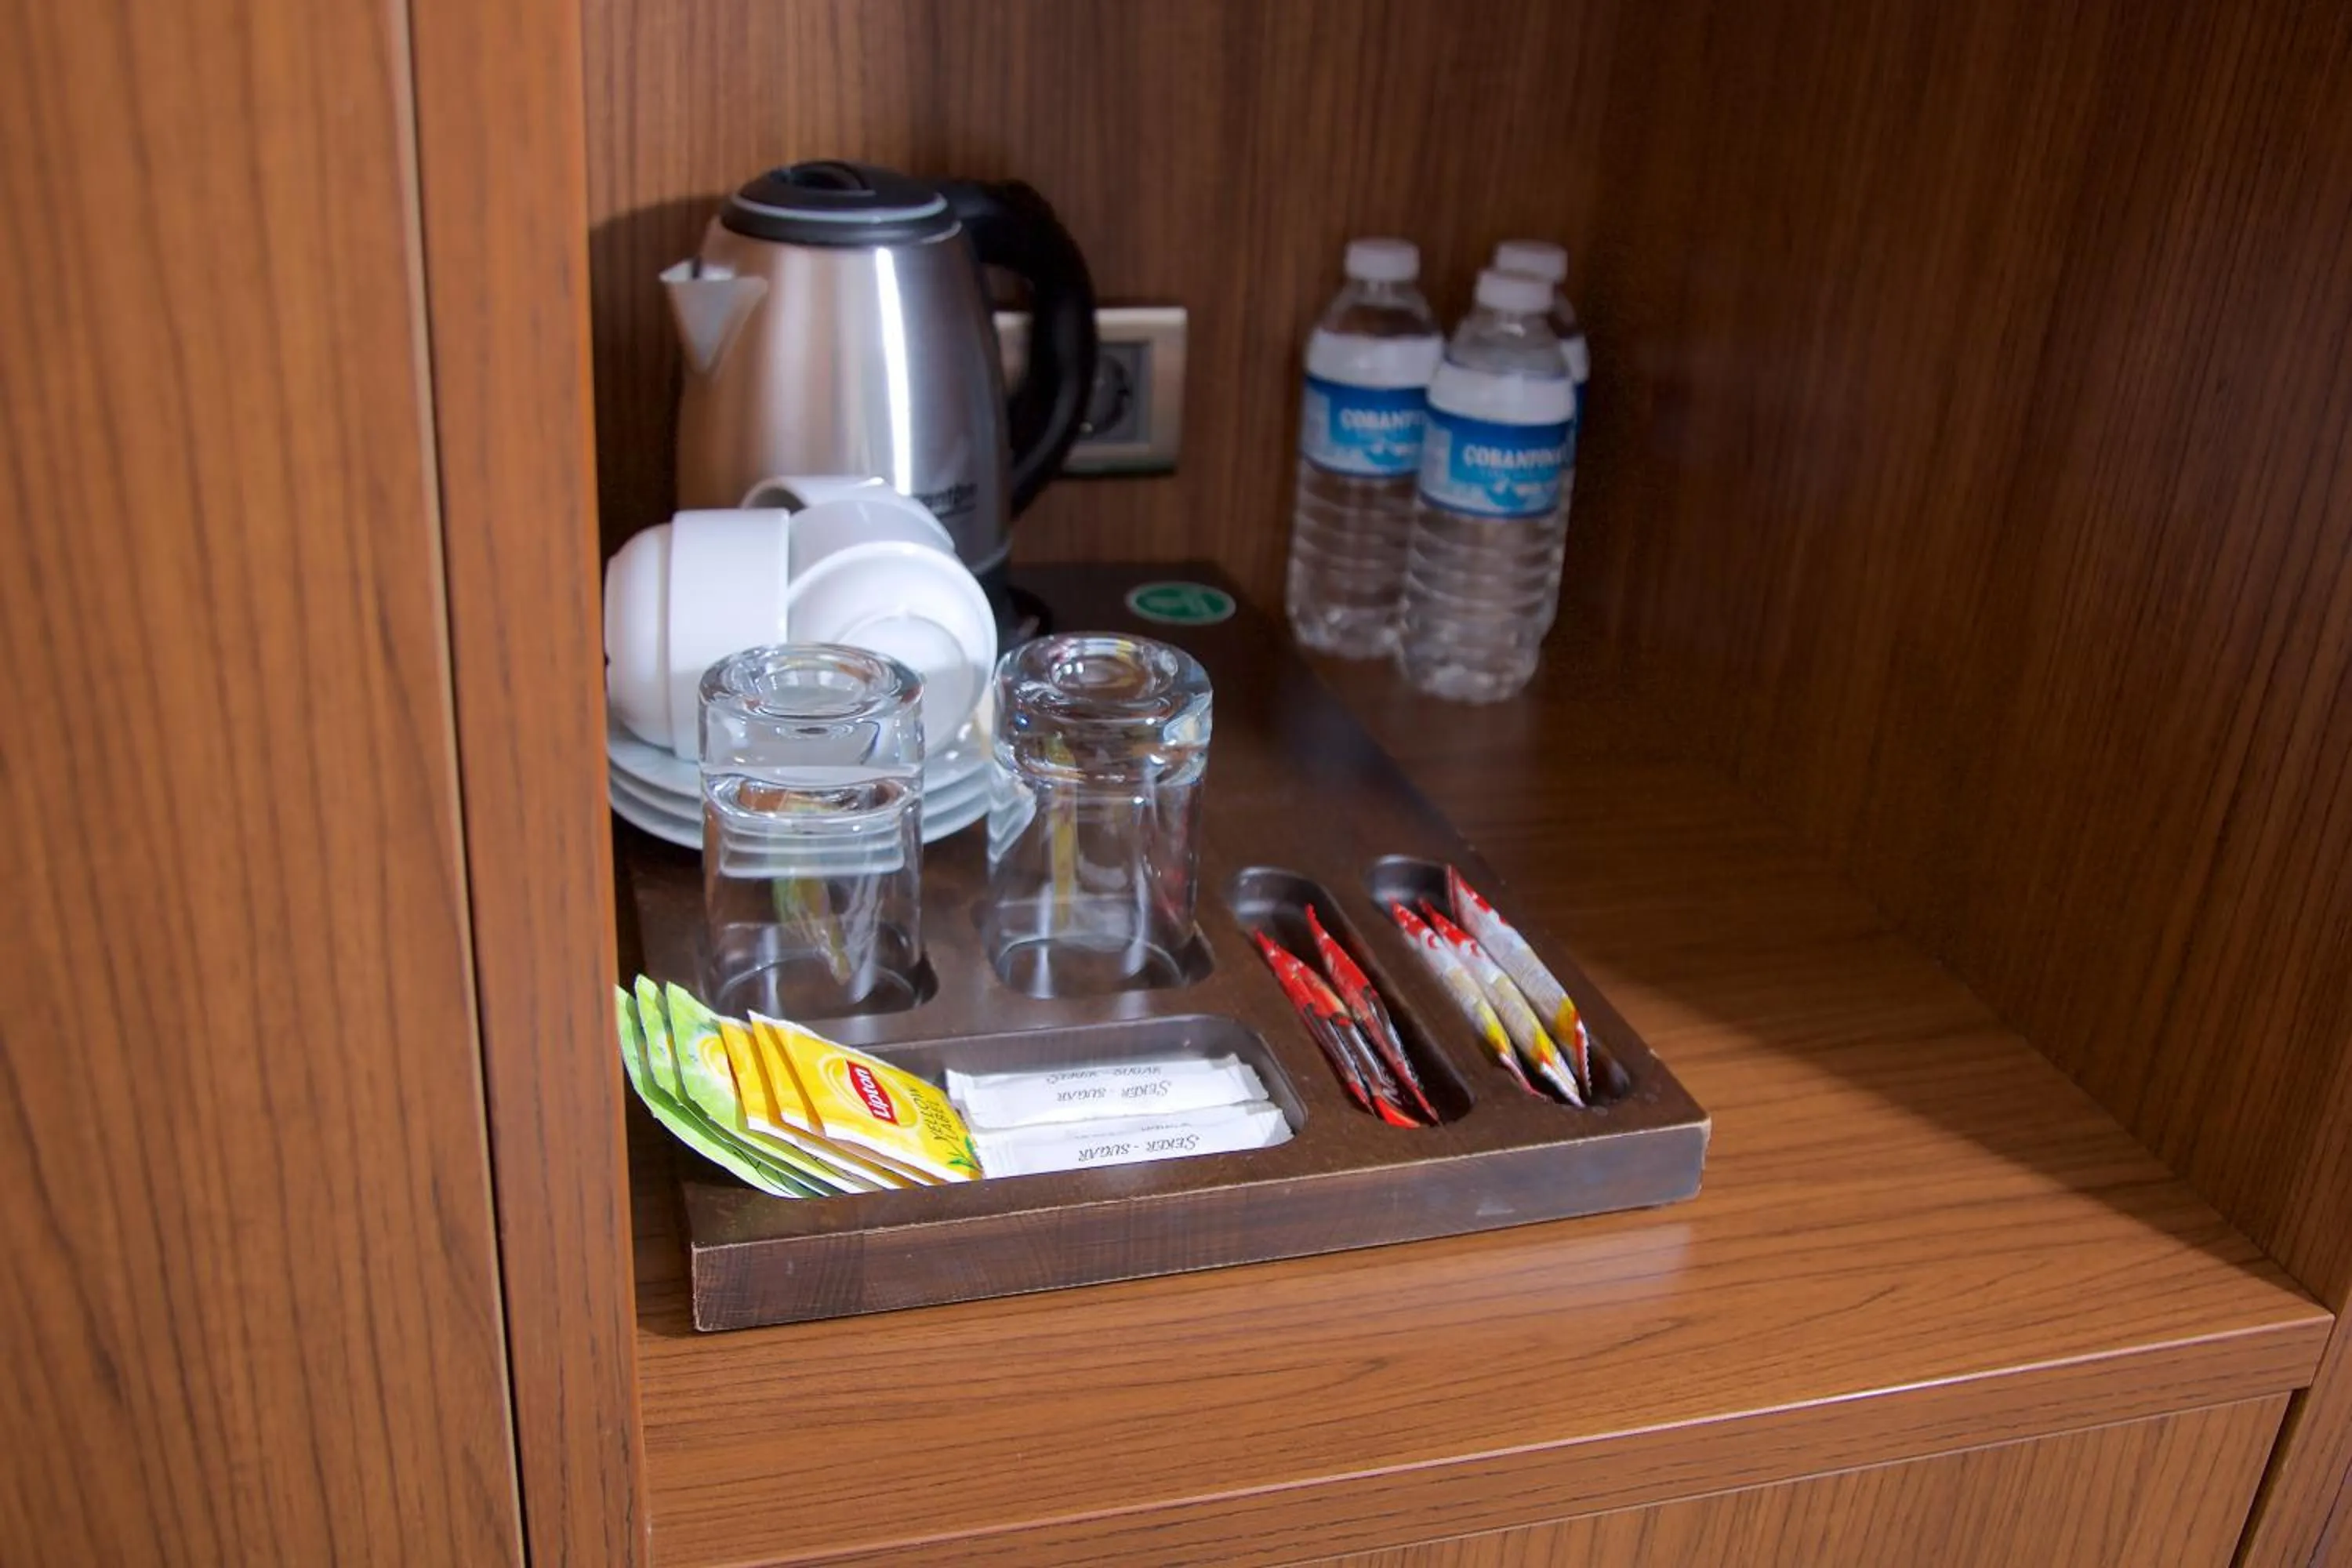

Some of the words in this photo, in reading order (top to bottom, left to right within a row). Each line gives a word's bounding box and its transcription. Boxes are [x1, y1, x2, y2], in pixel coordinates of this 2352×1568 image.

[853, 1067, 891, 1120] Lipton
[1057, 1087, 1106, 1102] SUGAR
[909, 1088, 948, 1142] YELLOW
[926, 1100, 960, 1142] LABEL
[1078, 1143, 1131, 1162] SUGAR
